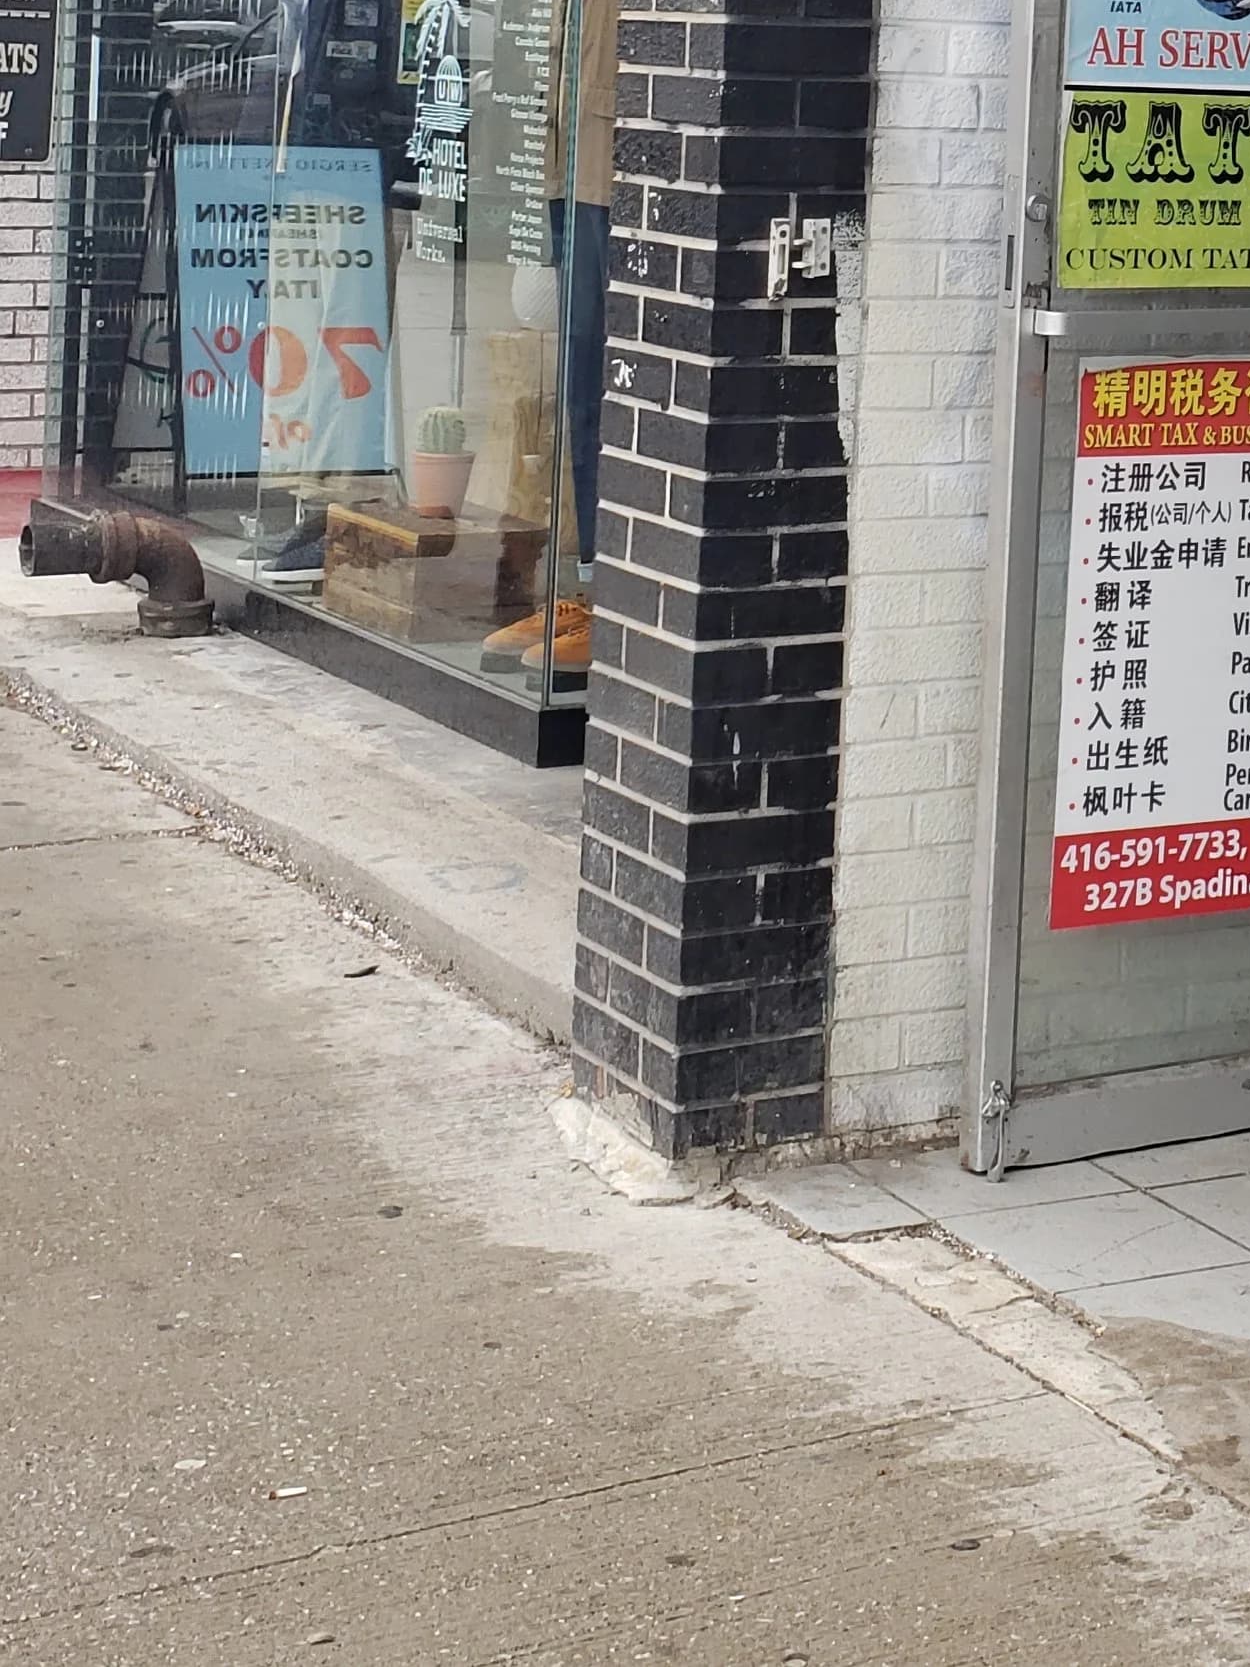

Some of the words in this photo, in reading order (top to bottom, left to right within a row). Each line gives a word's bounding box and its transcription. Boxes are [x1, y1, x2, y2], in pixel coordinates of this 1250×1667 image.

[1110, 1, 1142, 13] IATA
[1088, 27, 1145, 67] AH
[432, 138, 467, 169] HOTEL
[419, 167, 432, 196] DE
[438, 170, 466, 202] LUXE
[1088, 198, 1139, 227] TIN
[1154, 199, 1242, 227] DRUM
[1066, 247, 1194, 270] CUSTOM
[1084, 424, 1155, 451] SMART
[1160, 423, 1198, 446] TAX
[1203, 425, 1217, 445] &
[1100, 461, 1207, 494] 注册公司
[1096, 537, 1228, 574] 失业金申请
[1086, 737, 1169, 771] 出生纸
[1082, 781, 1167, 817] 枫叶卡
[1060, 829, 1247, 875] 416-591-7733,
[1084, 877, 1154, 912] 327B
